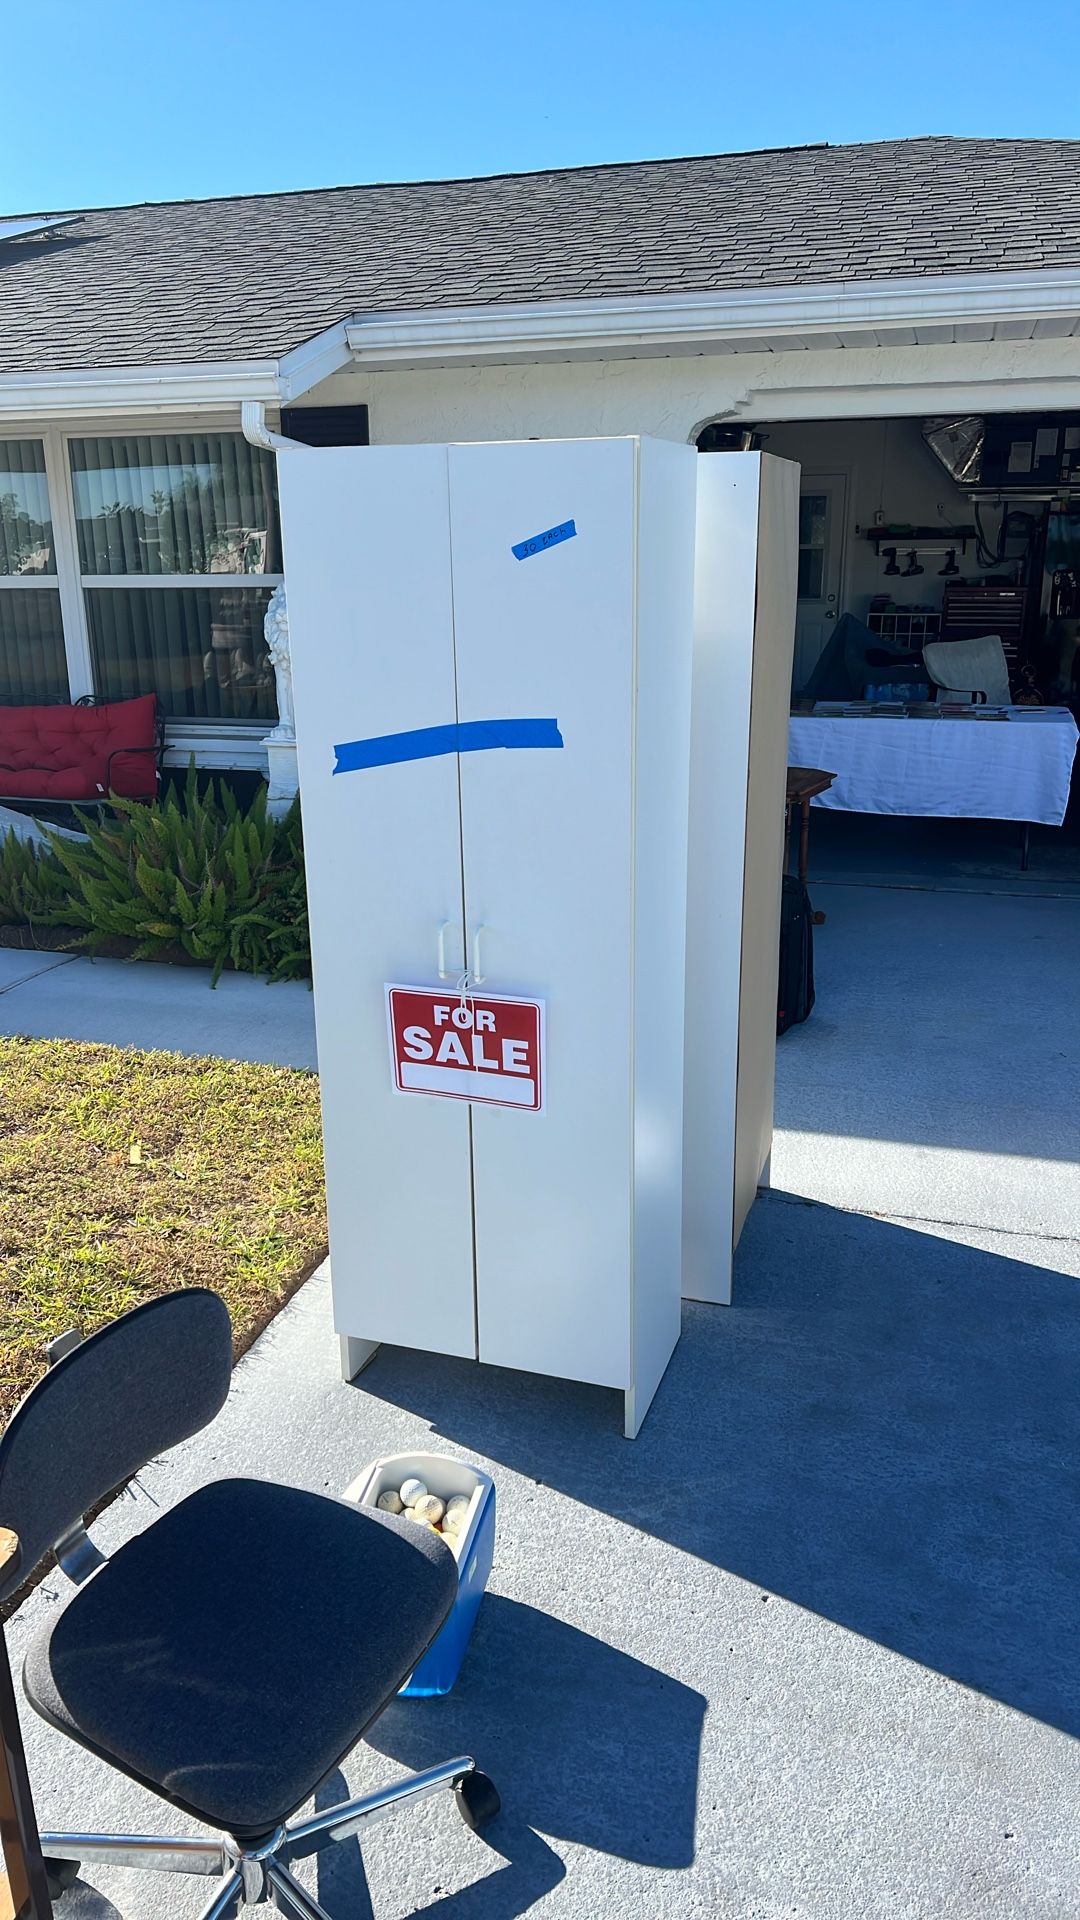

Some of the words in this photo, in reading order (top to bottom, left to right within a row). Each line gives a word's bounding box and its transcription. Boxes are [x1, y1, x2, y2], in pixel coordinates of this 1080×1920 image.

[523, 543, 537, 557] 30
[433, 1004, 497, 1033] FOR
[402, 1025, 531, 1075] SALE
